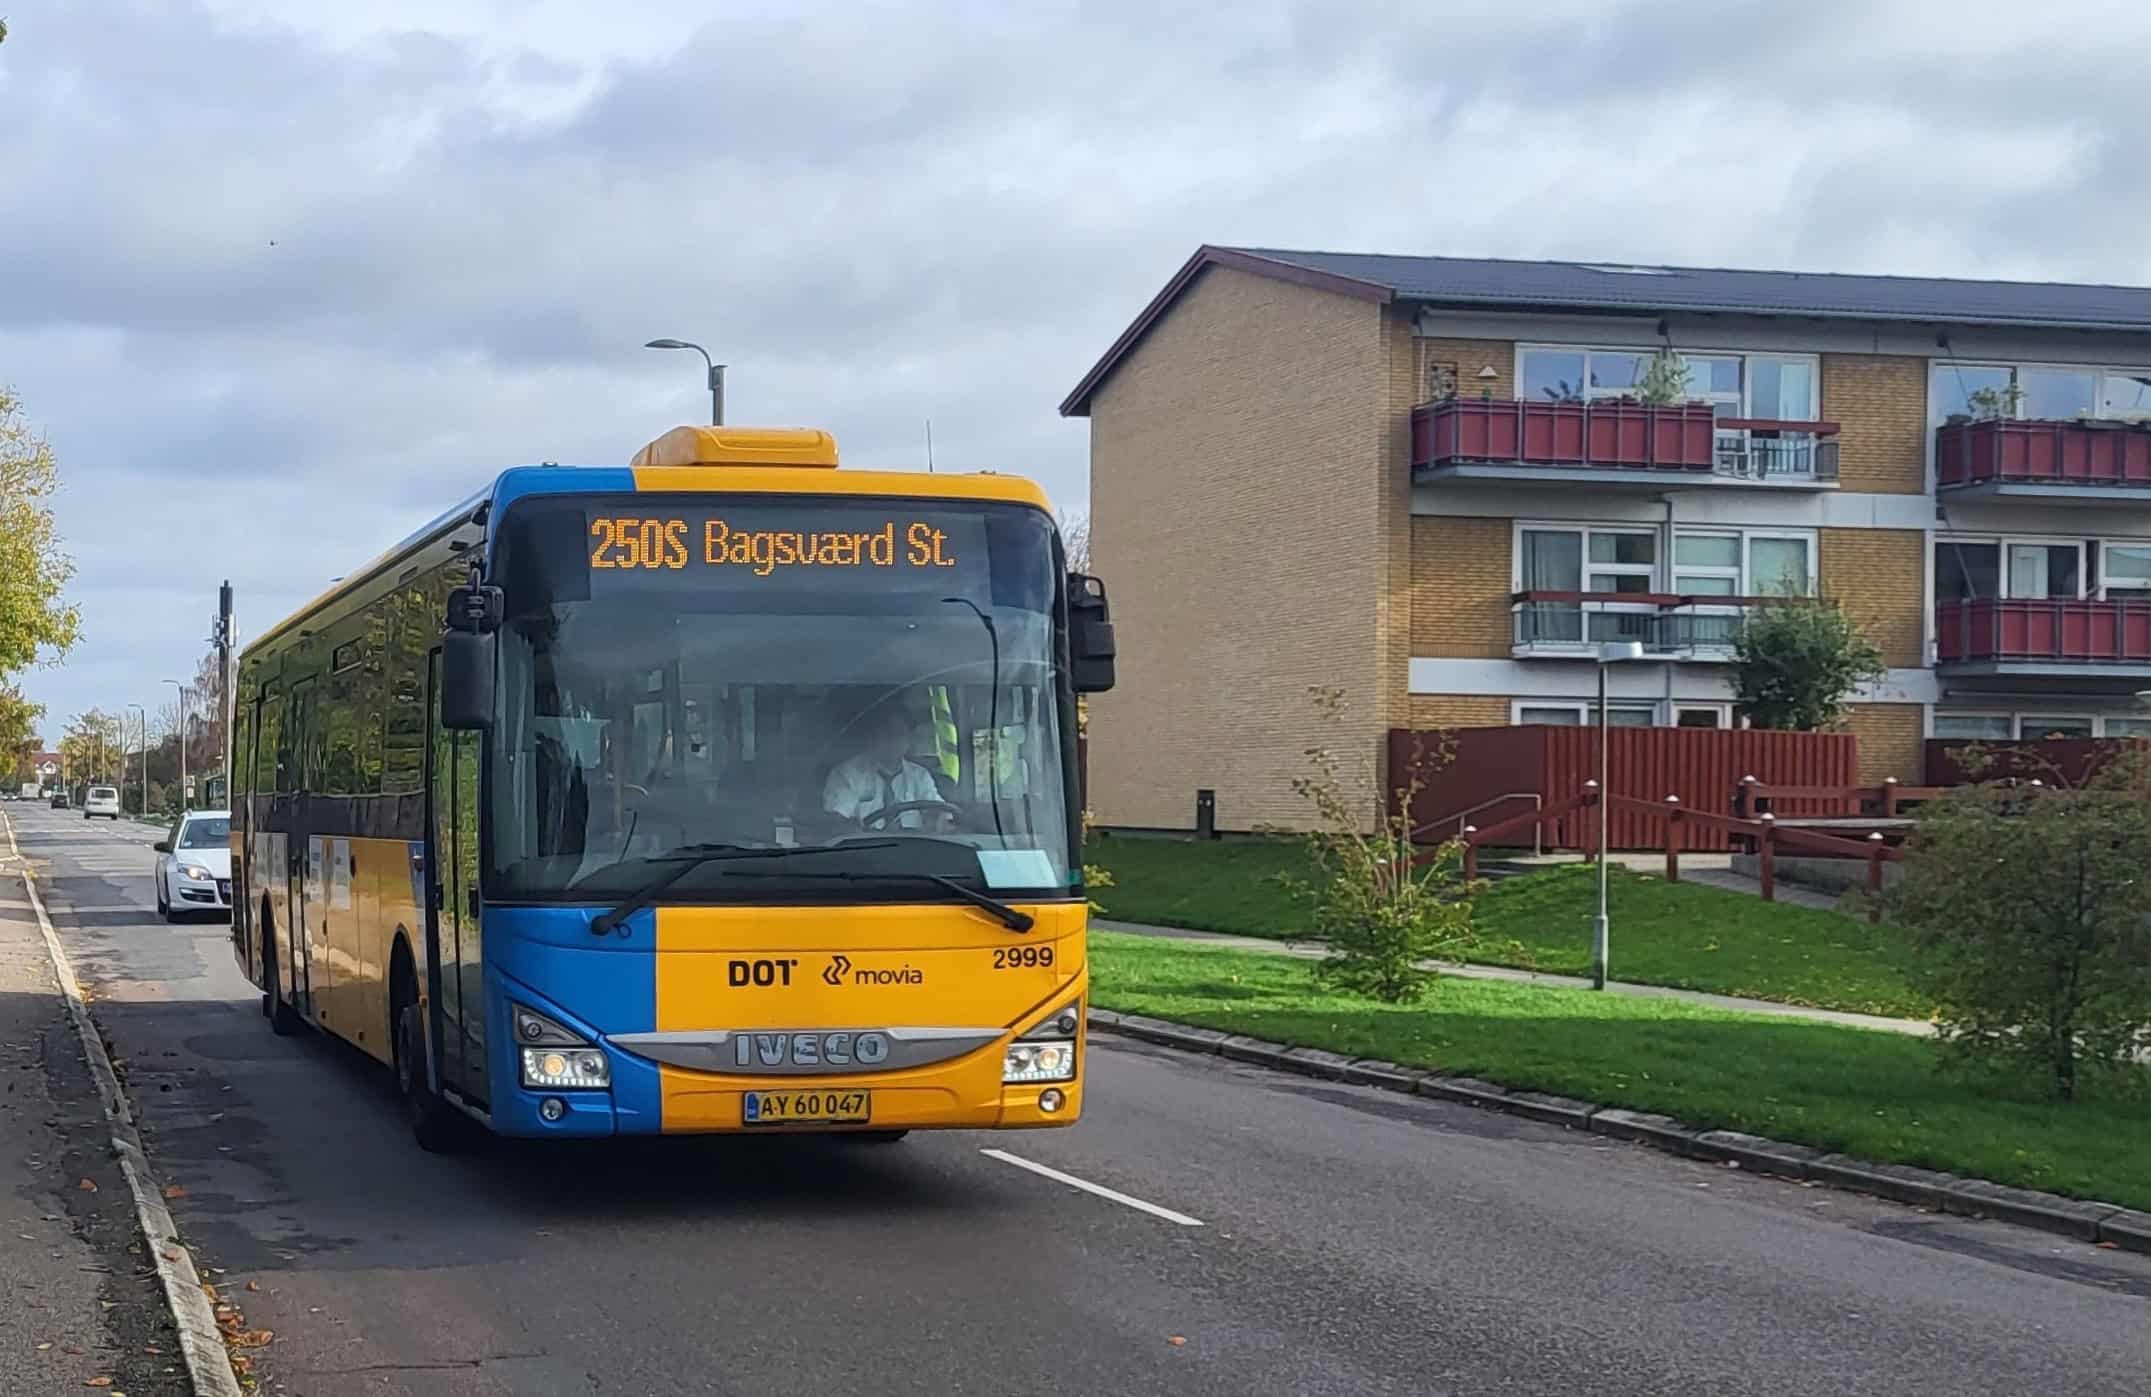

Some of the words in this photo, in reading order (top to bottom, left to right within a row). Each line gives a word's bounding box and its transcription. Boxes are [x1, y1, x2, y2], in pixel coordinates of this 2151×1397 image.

[591, 519, 689, 569] 250S
[908, 522, 955, 566] St.
[993, 946, 1054, 969] 2999
[728, 959, 798, 987] DOT
[855, 964, 923, 985] movia
[736, 1032, 889, 1066] IVECO
[795, 1094, 820, 1114] 60
[826, 1094, 865, 1114] 047
